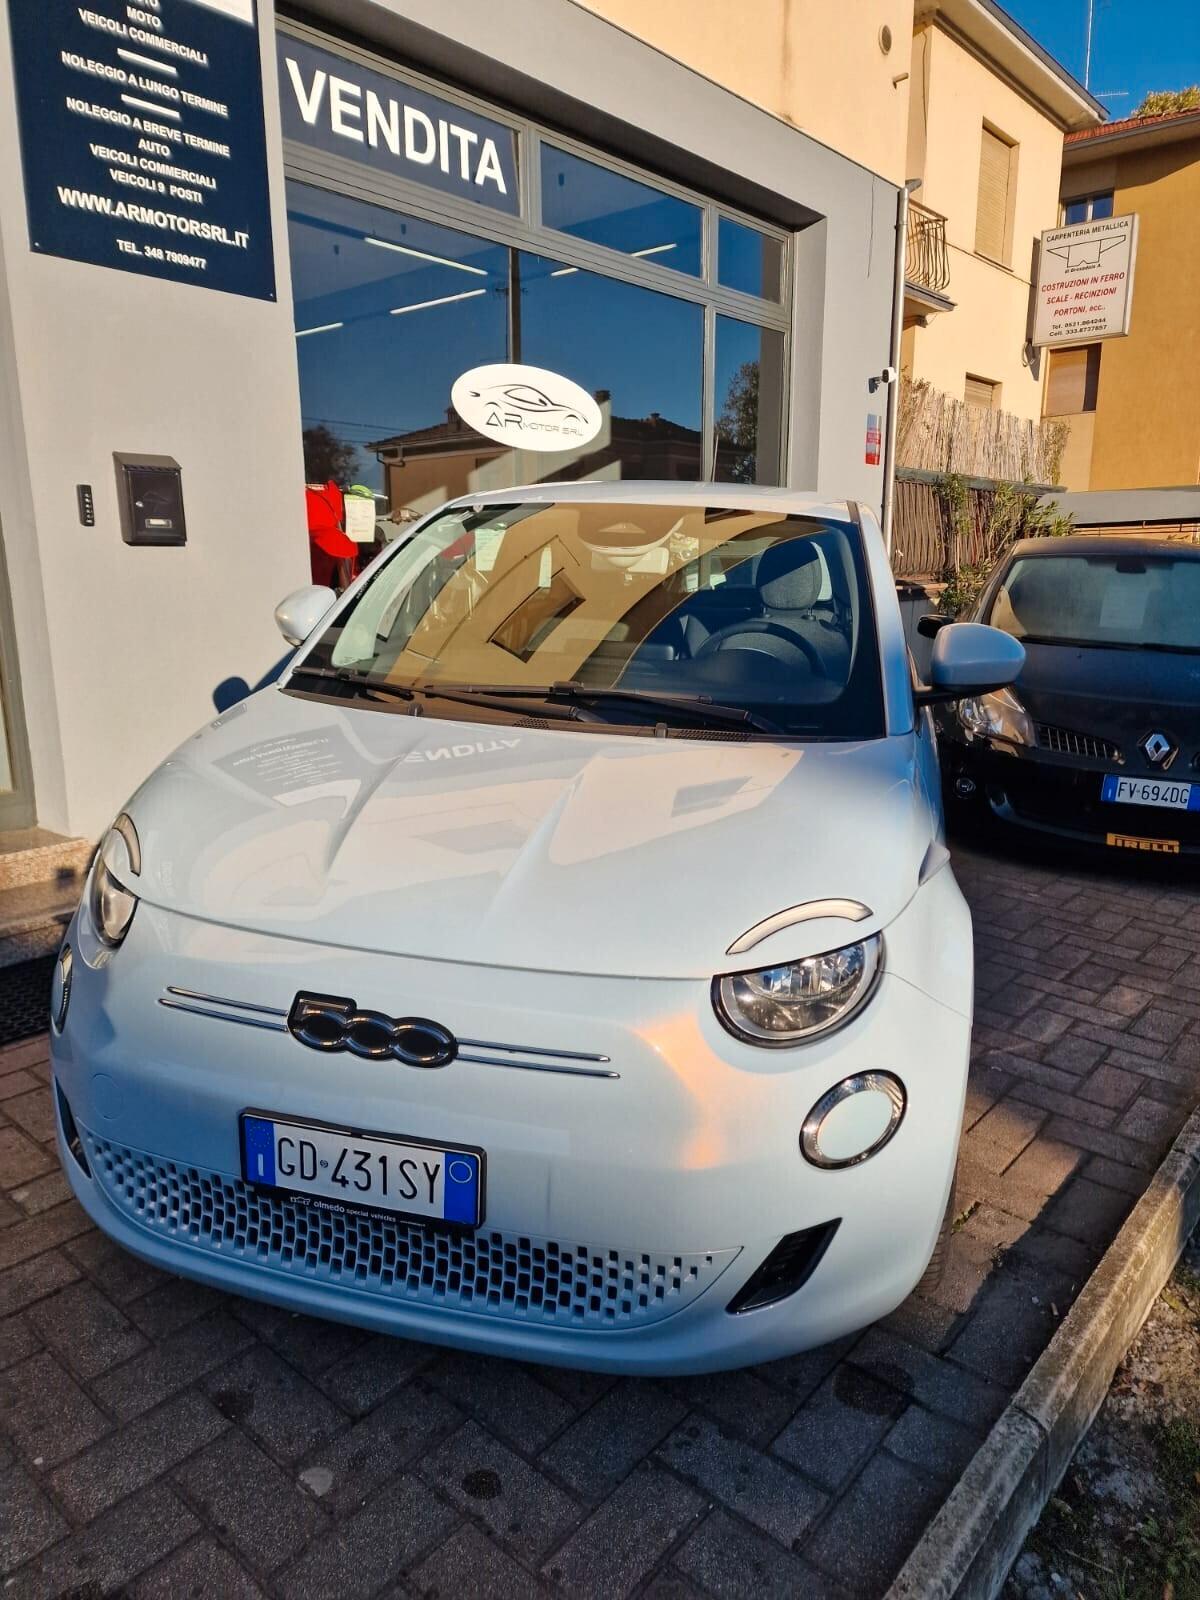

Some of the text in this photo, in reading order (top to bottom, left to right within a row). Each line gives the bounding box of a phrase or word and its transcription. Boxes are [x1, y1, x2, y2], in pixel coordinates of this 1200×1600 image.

[126, 5, 161, 28] MOTO
[78, 8, 208, 64] VEICOLI COMMERCIALI
[61, 51, 229, 117] NOLEGGIO A LUNGO TERMINE
[66, 97, 231, 157] NOLEGGIO A BREVE TERMINE
[285, 57, 507, 194] VENDITA
[138, 138, 171, 156] AUTO
[90, 143, 217, 189] VEICOLI COMMERCIALI
[110, 168, 203, 203] VEICOLI 9 POSTI
[57, 186, 249, 249] WWW.ARMOTORSRL.IT
[1046, 221, 1129, 243] CARPENTERIA METALLICA
[116, 239, 207, 269] TEL. 348 7909477
[1041, 271, 1126, 293] COSTRUZIONI IN FERRO
[1046, 295, 1070, 305] SCALE
[1074, 287, 1117, 300] RECINZIONI
[1117, 781, 1138, 799] FV
[1141, 784, 1190, 804] 694DG
[1106, 832, 1180, 854] PIRELLI
[287, 990, 458, 1068] 500
[277, 1136, 318, 1181] GD
[313, 1200, 397, 1223] olmedo special vehicles
